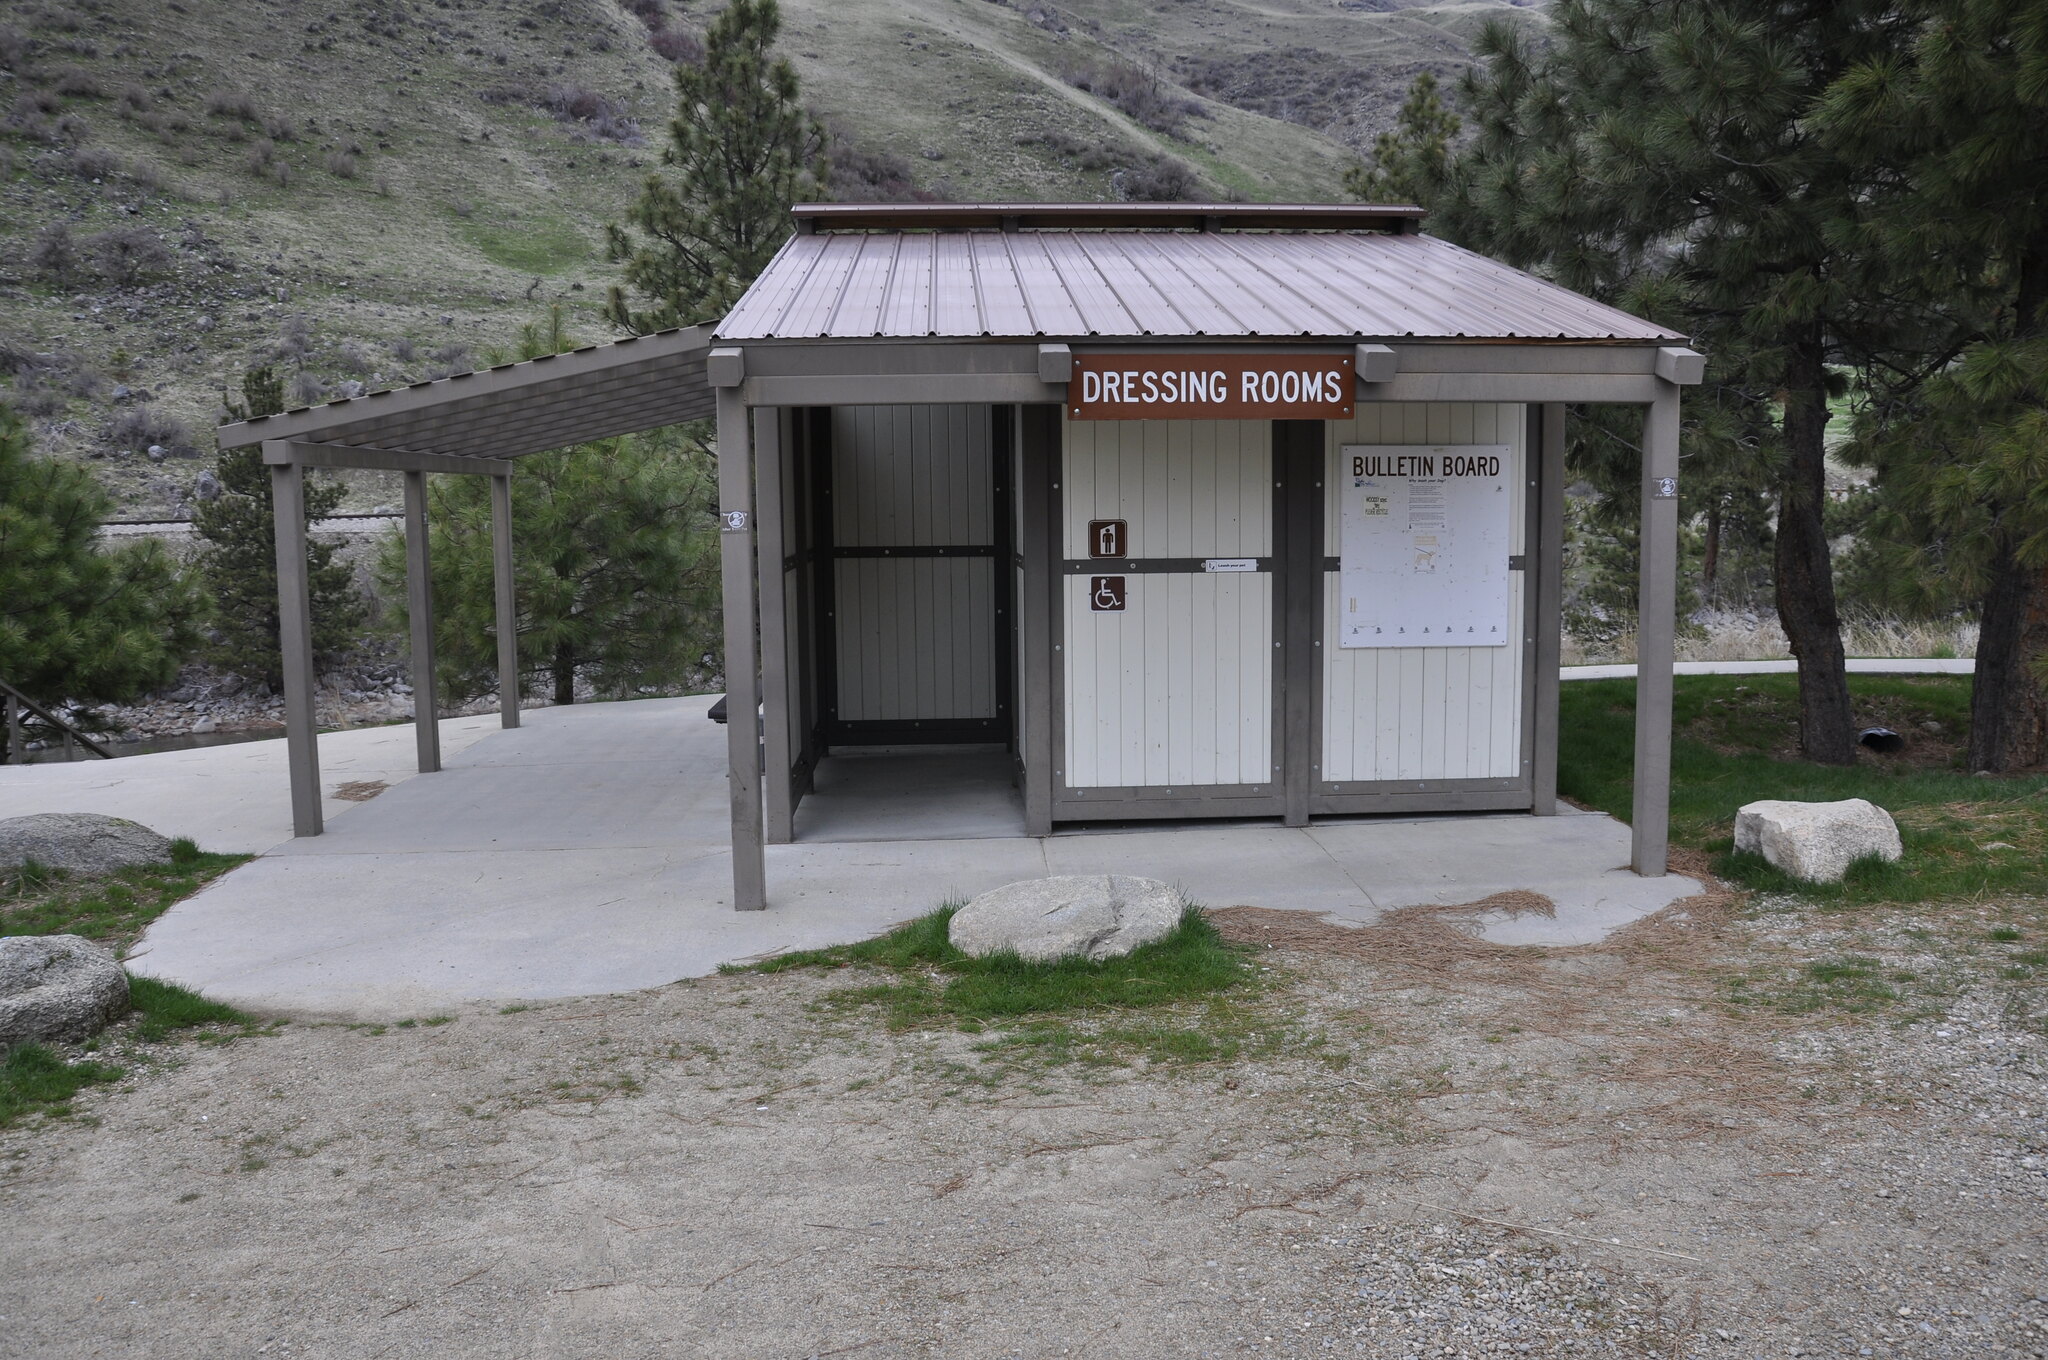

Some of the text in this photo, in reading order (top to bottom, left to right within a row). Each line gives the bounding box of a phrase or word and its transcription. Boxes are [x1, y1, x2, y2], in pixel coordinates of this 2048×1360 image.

[1082, 370, 1342, 403] DRESSING ROOMS
[1353, 456, 1500, 477] BULLETIN BOARD
